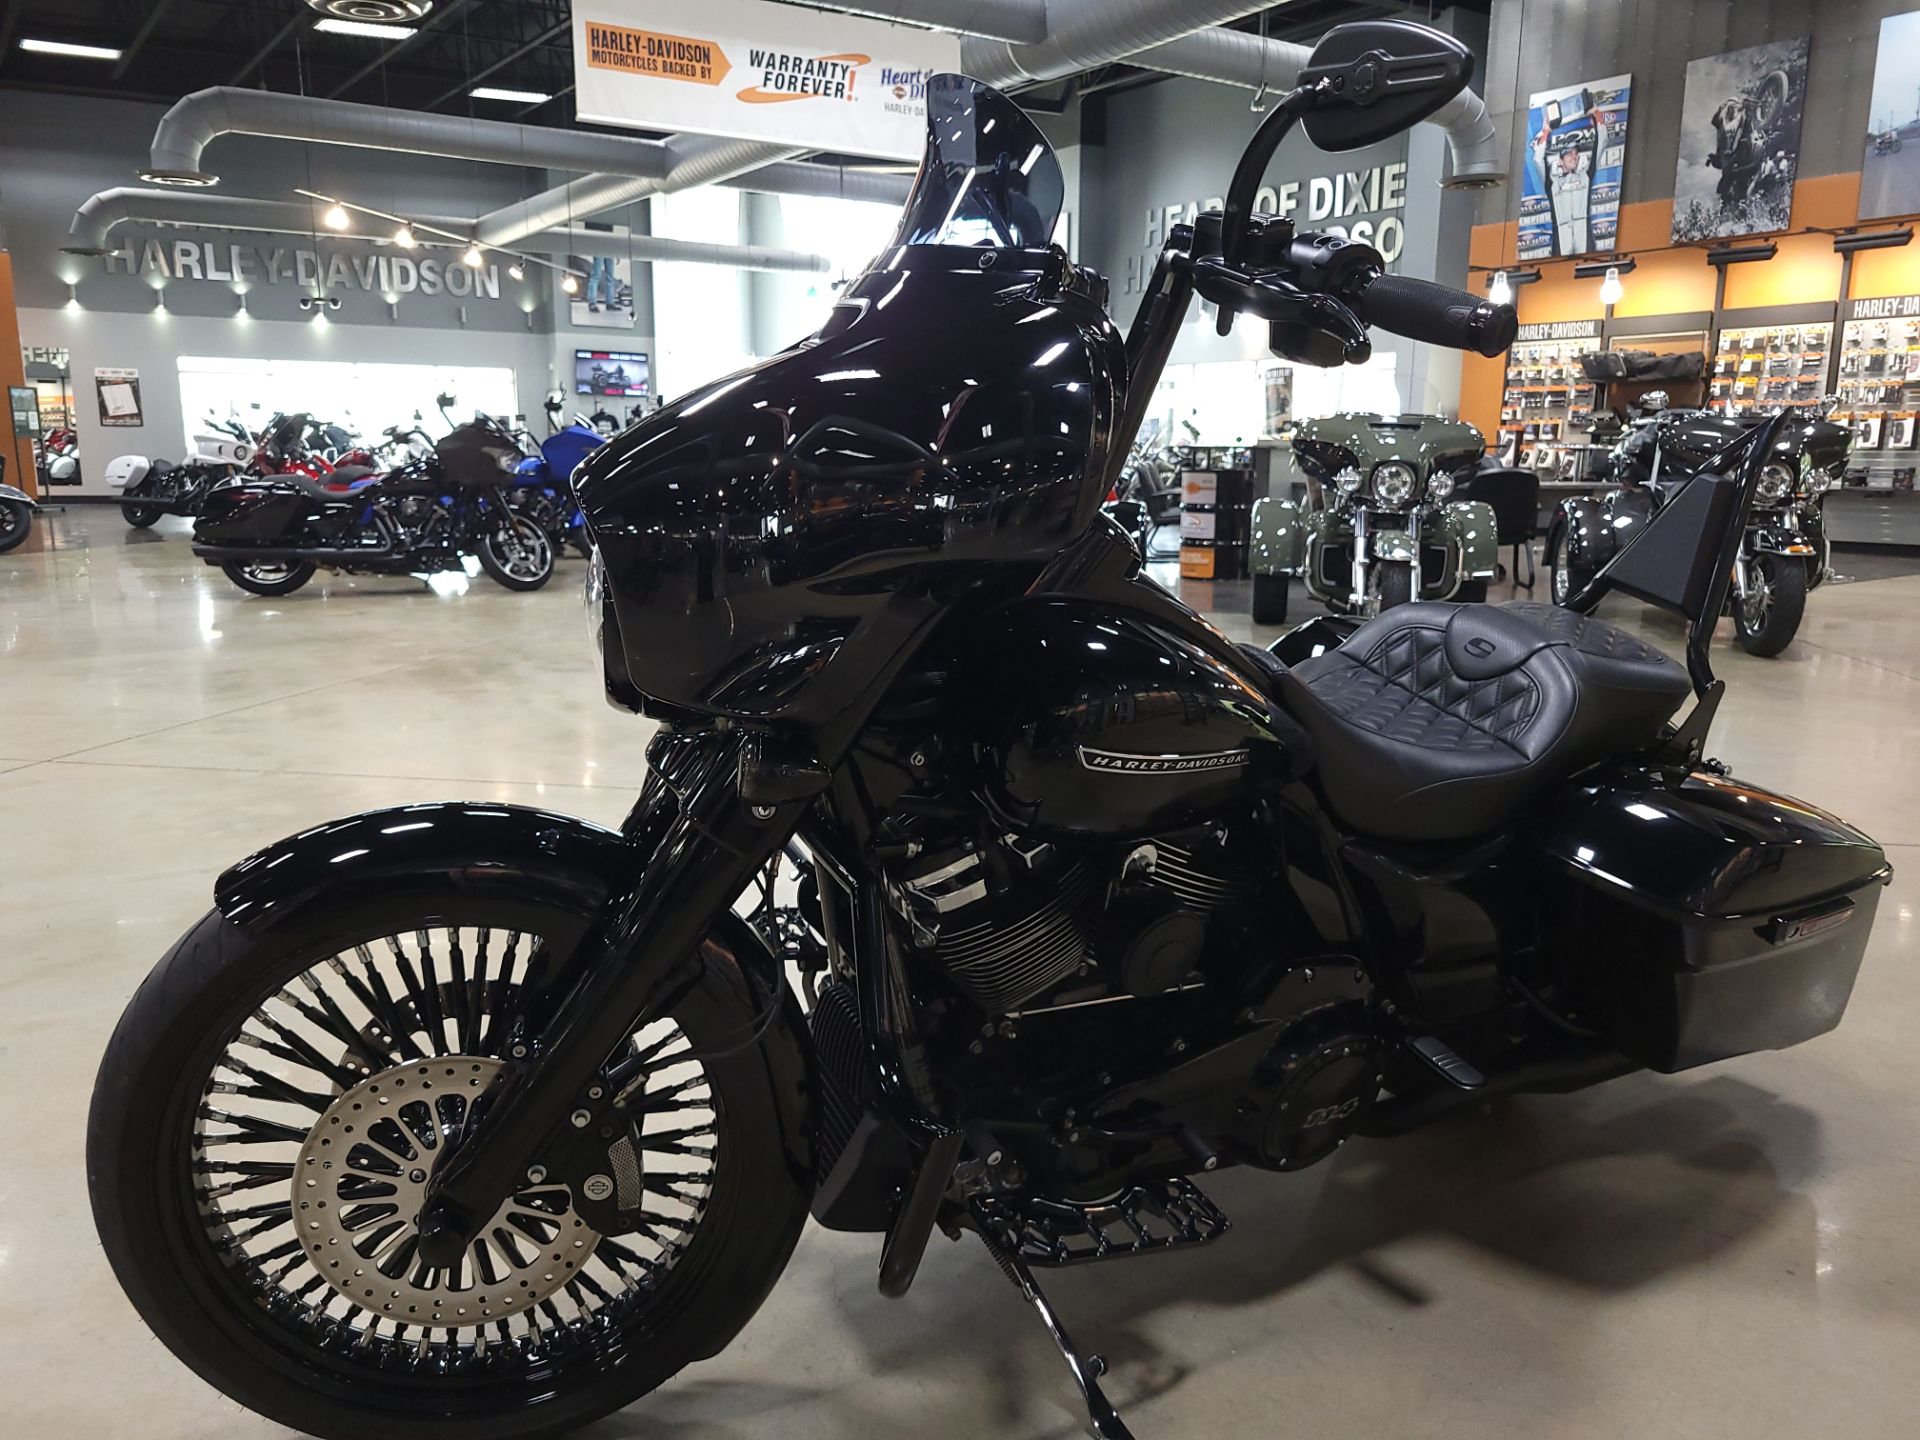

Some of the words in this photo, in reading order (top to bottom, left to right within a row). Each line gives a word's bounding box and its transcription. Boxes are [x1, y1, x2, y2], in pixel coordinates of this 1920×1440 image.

[591, 28, 711, 65] HARLEY-DAVIDSON
[592, 50, 658, 72] MOTORCYCLES
[663, 60, 696, 77] BACKED
[701, 66, 711, 79] BY
[750, 49, 850, 81] WARRANTY
[881, 68, 921, 86] Heart
[1253, 182, 1300, 217] OF
[1308, 162, 1407, 222] DIXIE
[106, 237, 500, 299] HARLEY-DAVIDSON
[1518, 321, 1595, 340] HARLEY-DAVIDSON
[1092, 755, 1245, 770] HARLEY-DAVIDSON
